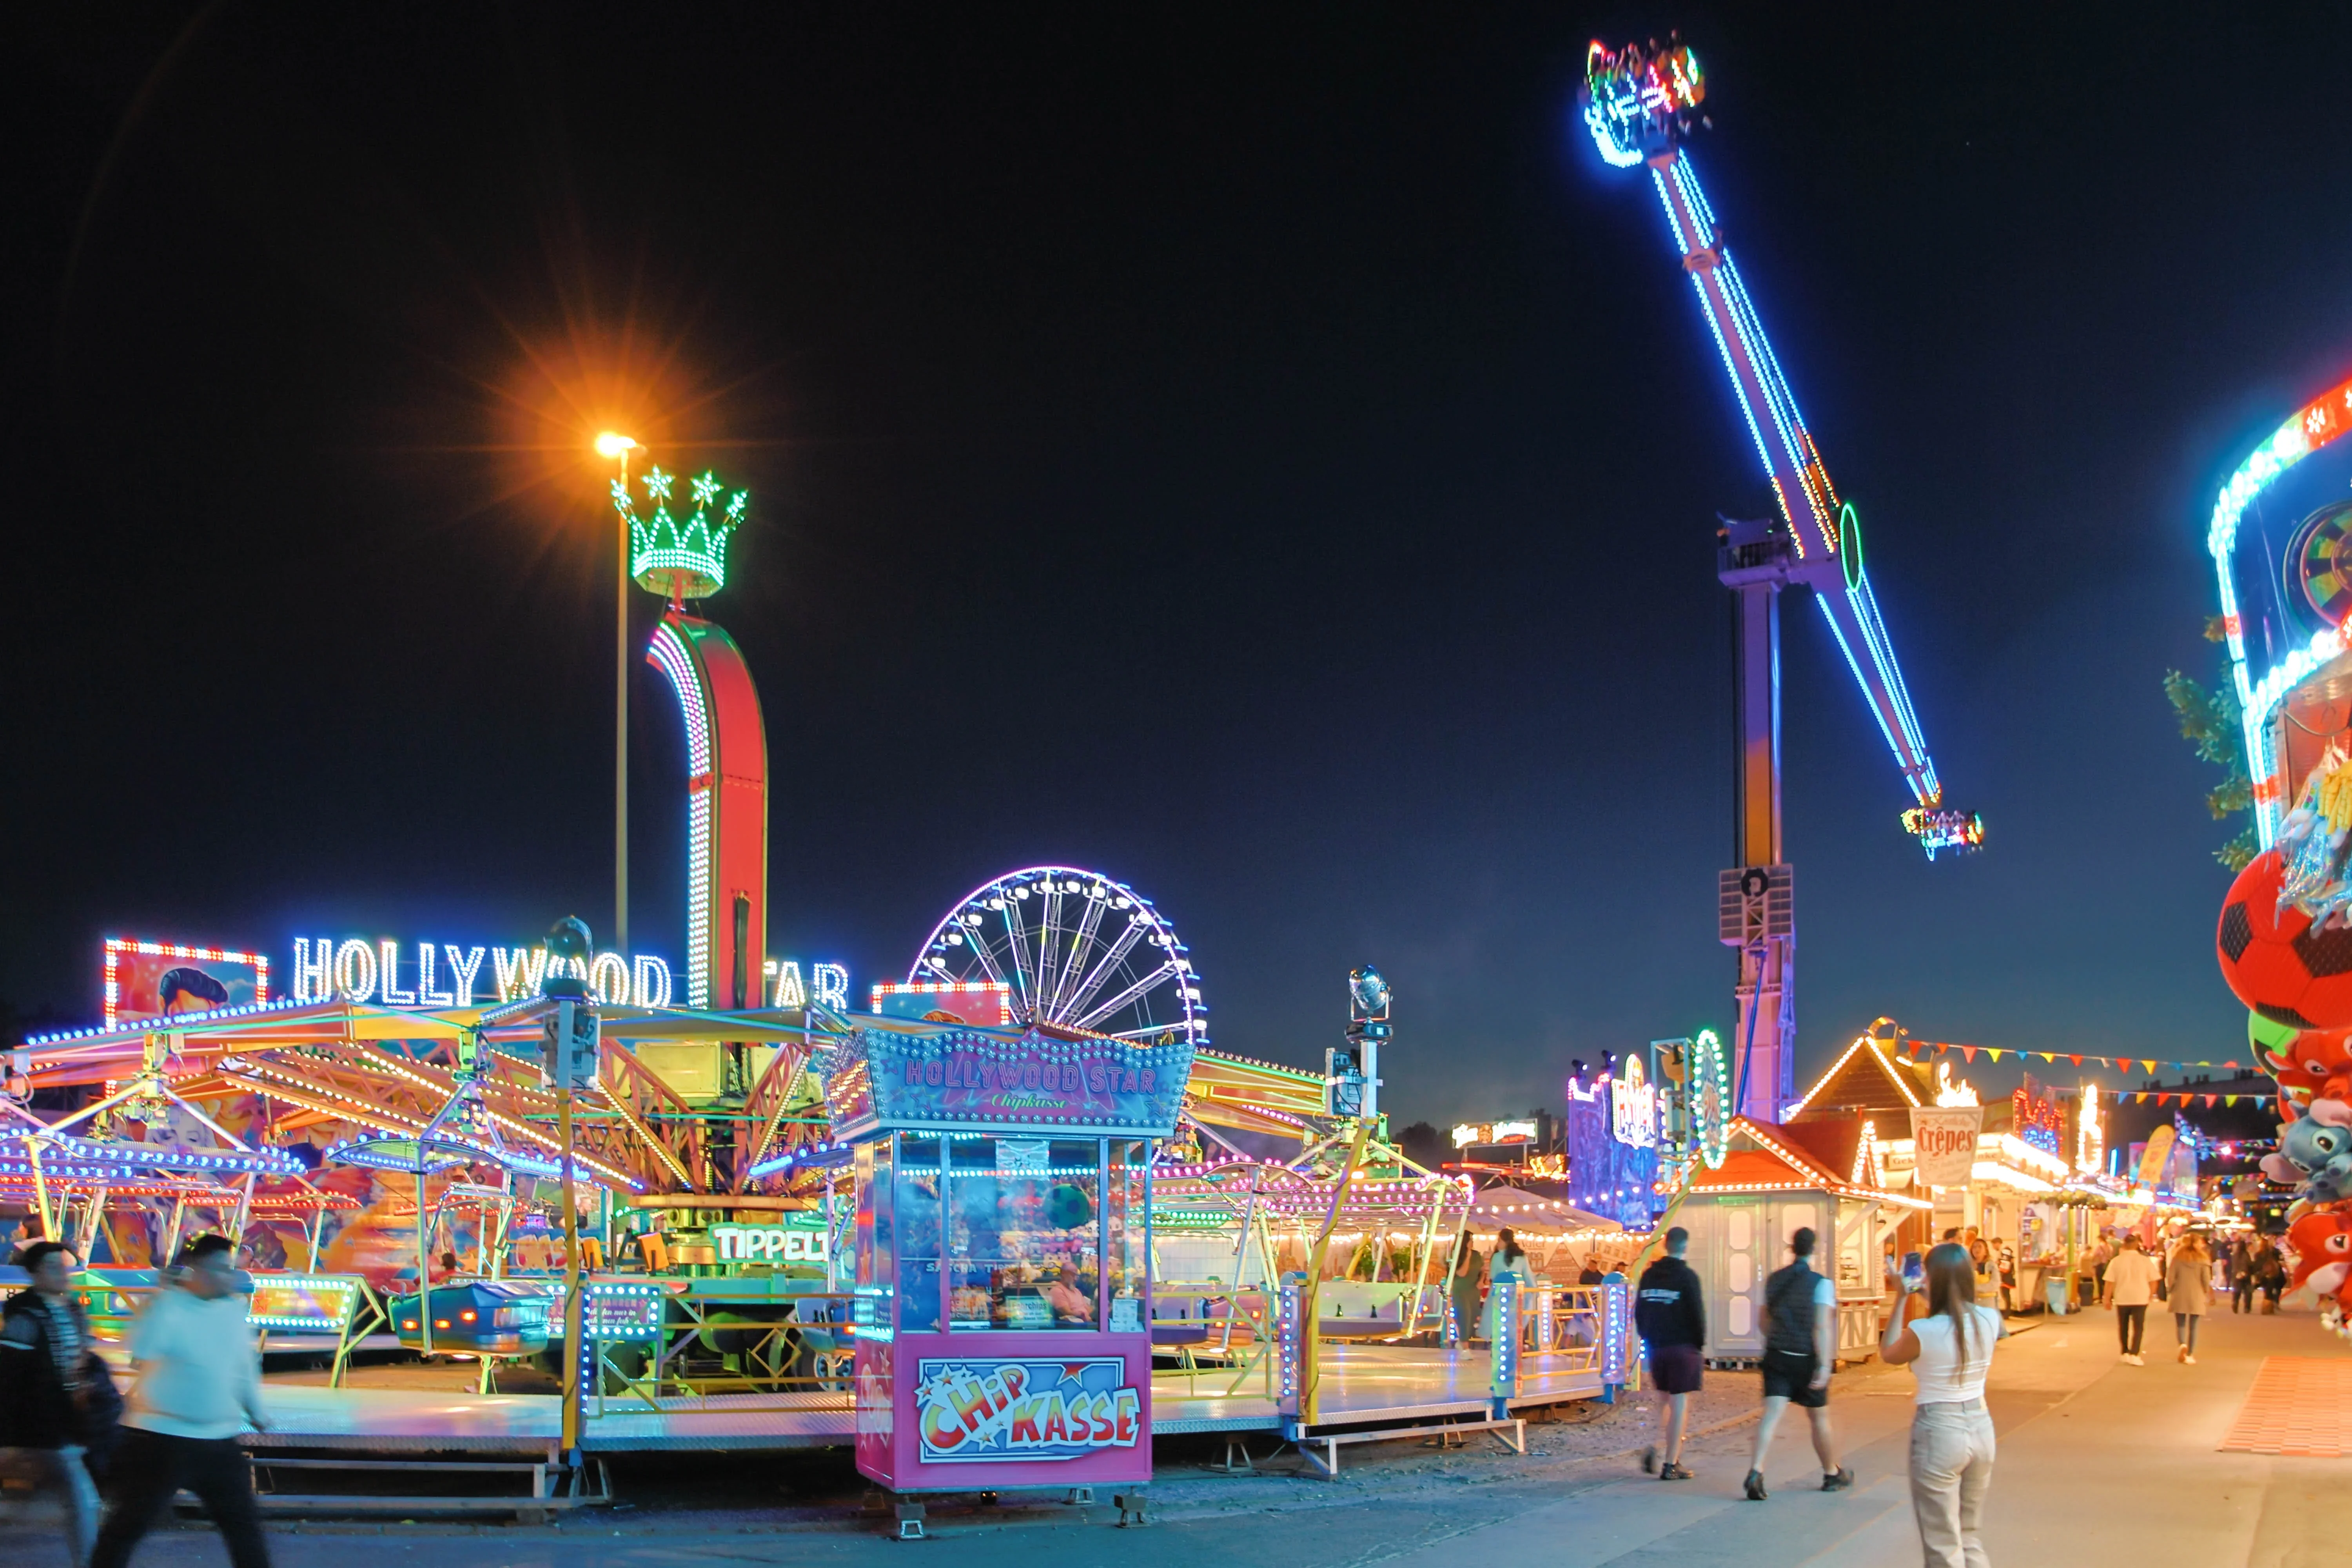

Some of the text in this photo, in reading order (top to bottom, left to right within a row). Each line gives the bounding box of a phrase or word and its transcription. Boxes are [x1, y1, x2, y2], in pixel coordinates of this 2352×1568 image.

[905, 1059, 1156, 1094] HOLLYWOOD STAR
[991, 1093, 1067, 1112] Chipkasse
[1918, 1126, 1974, 1155] Crêpes
[1009, 1392, 1138, 1445] KASSE
